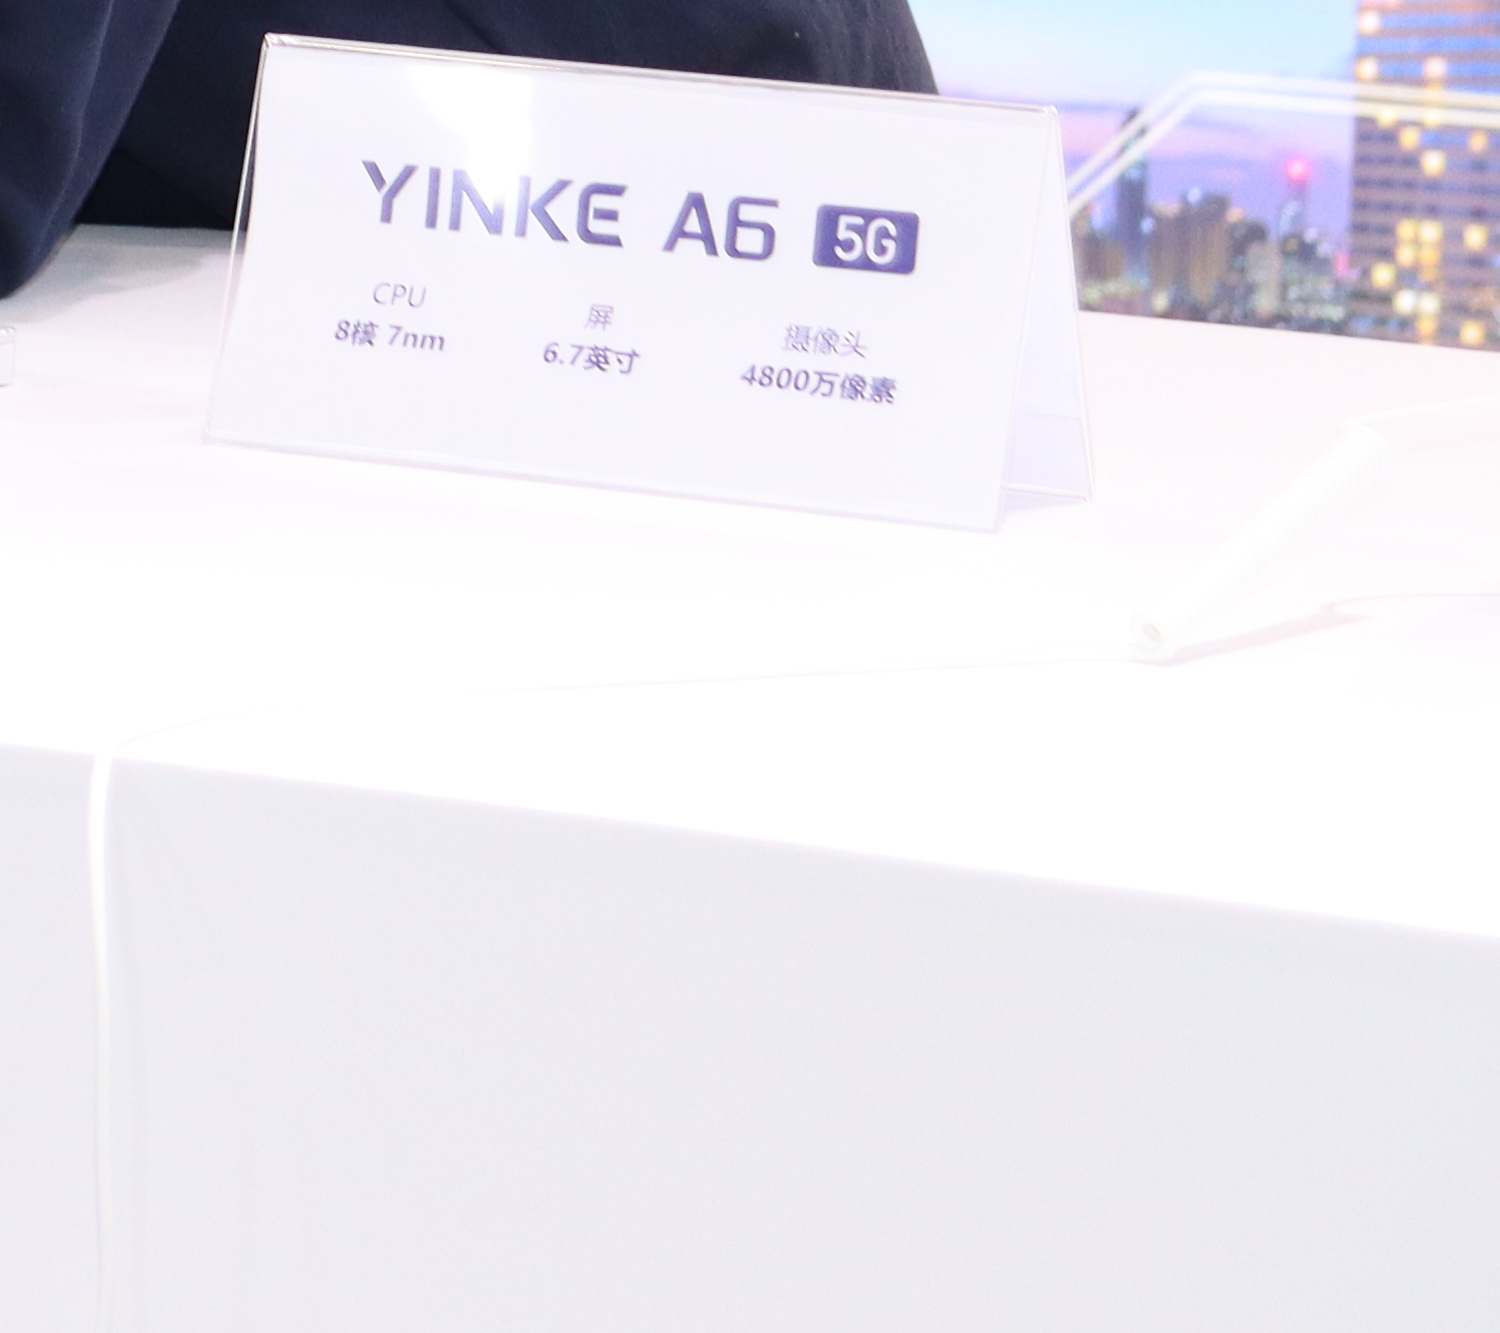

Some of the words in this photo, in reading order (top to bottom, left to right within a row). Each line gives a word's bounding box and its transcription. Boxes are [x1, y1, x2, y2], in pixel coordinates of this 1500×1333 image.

[362, 160, 628, 248] YINKE
[660, 191, 780, 261] A6
[372, 282, 427, 309] CPU
[587, 304, 614, 330] 屏
[783, 323, 868, 359] 摄像头
[542, 342, 640, 376] 6.7英寸
[740, 363, 897, 407] 4800万像素
